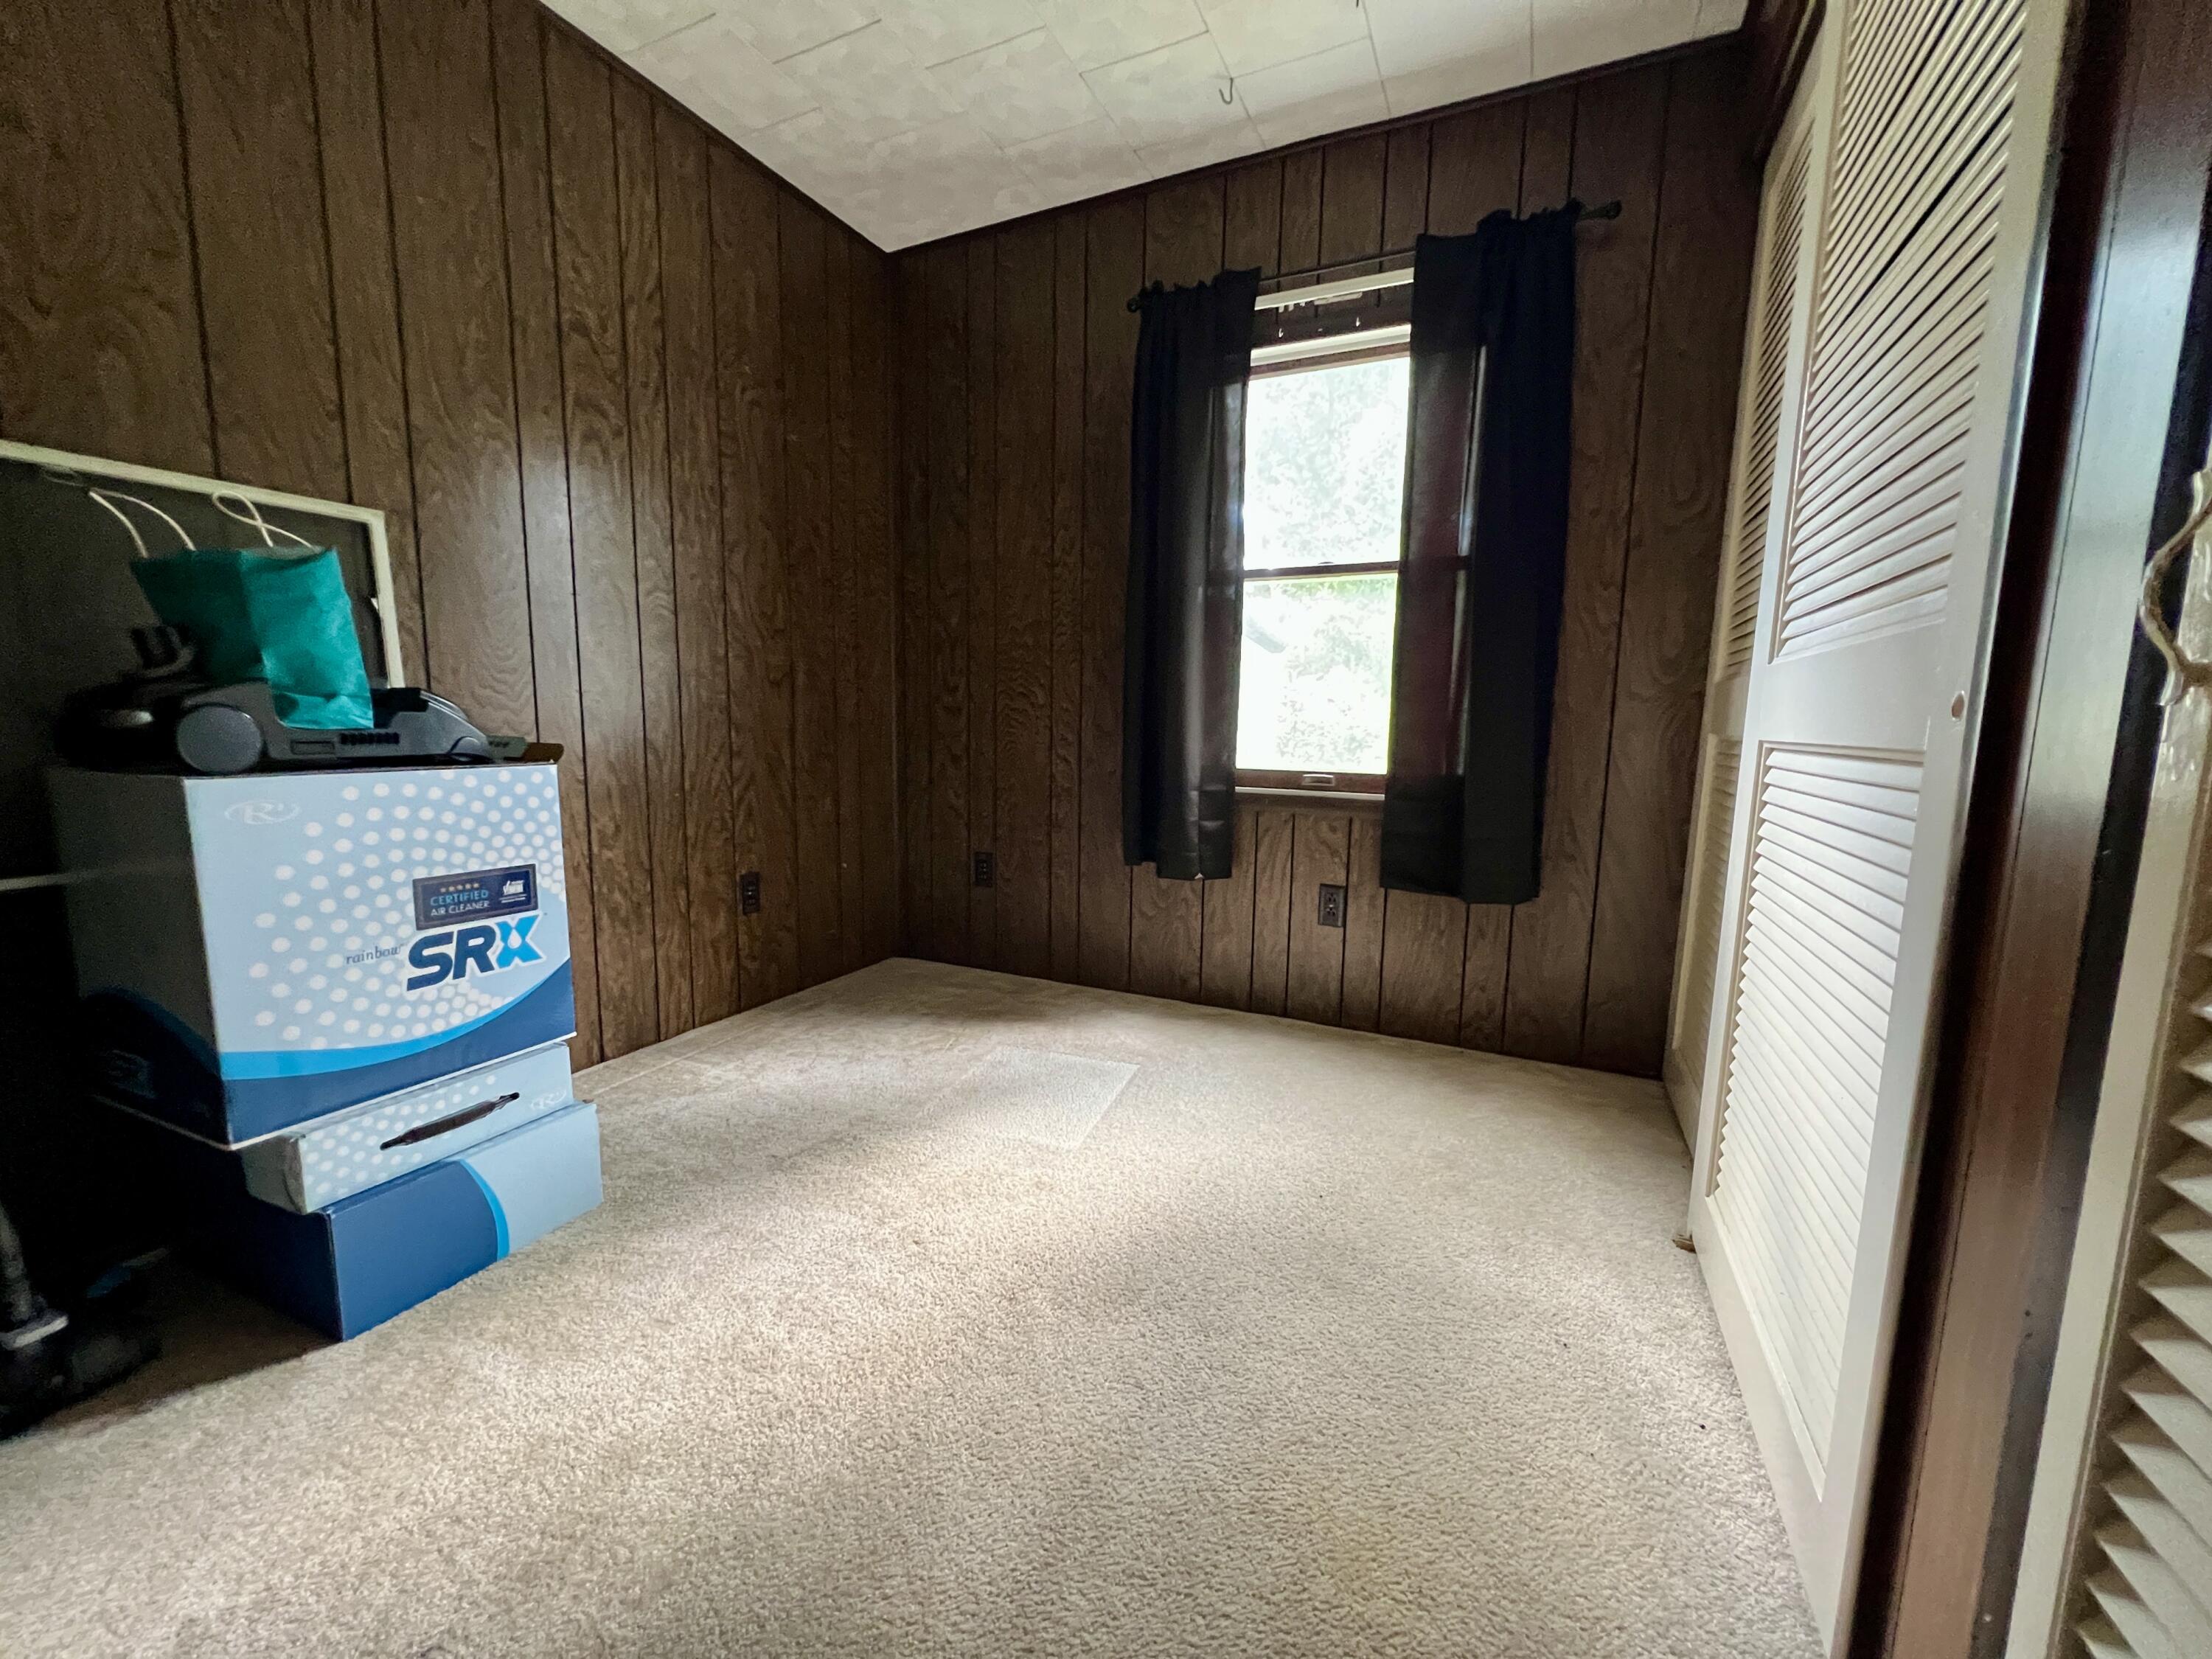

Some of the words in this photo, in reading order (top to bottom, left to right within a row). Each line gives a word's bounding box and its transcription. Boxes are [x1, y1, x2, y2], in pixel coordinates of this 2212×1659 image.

[430, 889, 490, 906] CERTIFIED
[431, 908, 446, 916] AIR
[448, 901, 490, 914] CLEANER
[406, 914, 543, 992] SRX
